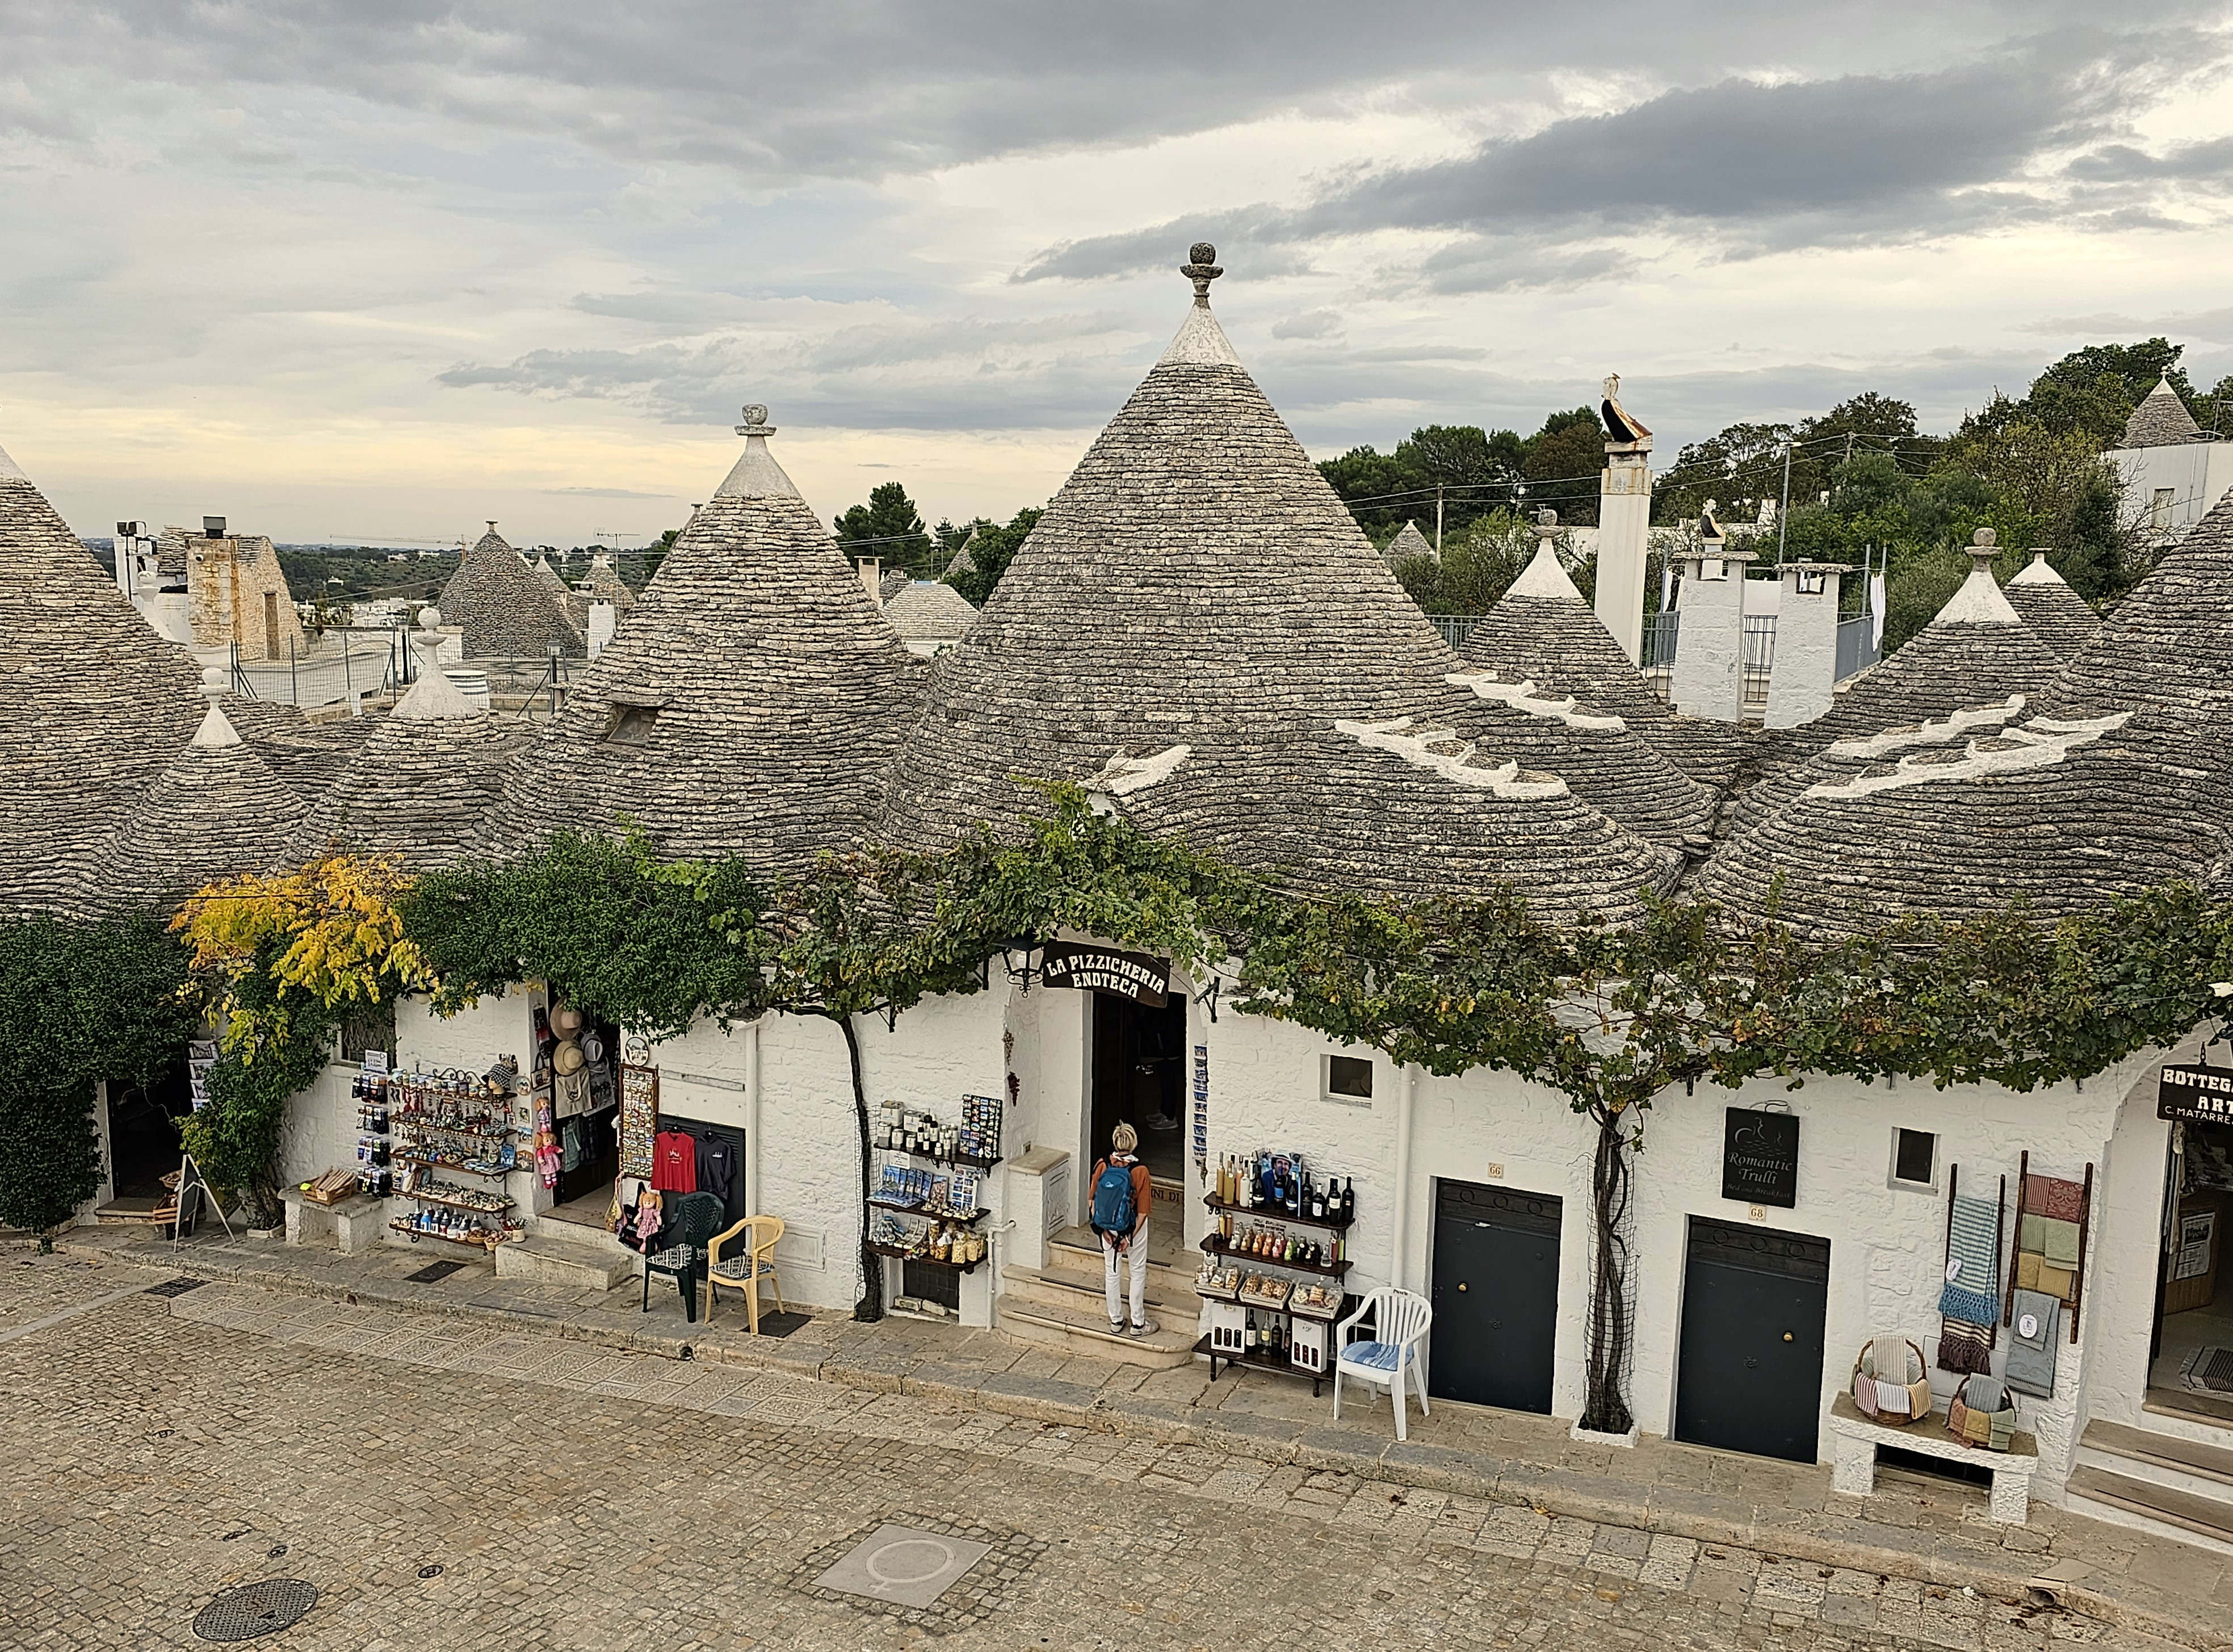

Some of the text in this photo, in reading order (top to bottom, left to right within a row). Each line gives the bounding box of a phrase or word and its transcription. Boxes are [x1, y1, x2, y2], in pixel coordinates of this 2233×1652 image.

[1046, 954, 1165, 994] LA PIZZICHERIA
[1071, 972, 1139, 998] ENOTECA
[2162, 1068, 2233, 1093] BOTTEG
[2177, 1108, 2233, 1125] MATARRE
[1727, 1151, 1793, 1172] Romantic
[1490, 1166, 1501, 1175] 66
[1739, 1168, 1778, 1185] Trulli
[1169, 1191, 1180, 1202] DI
[1751, 1208, 1763, 1218] 68
